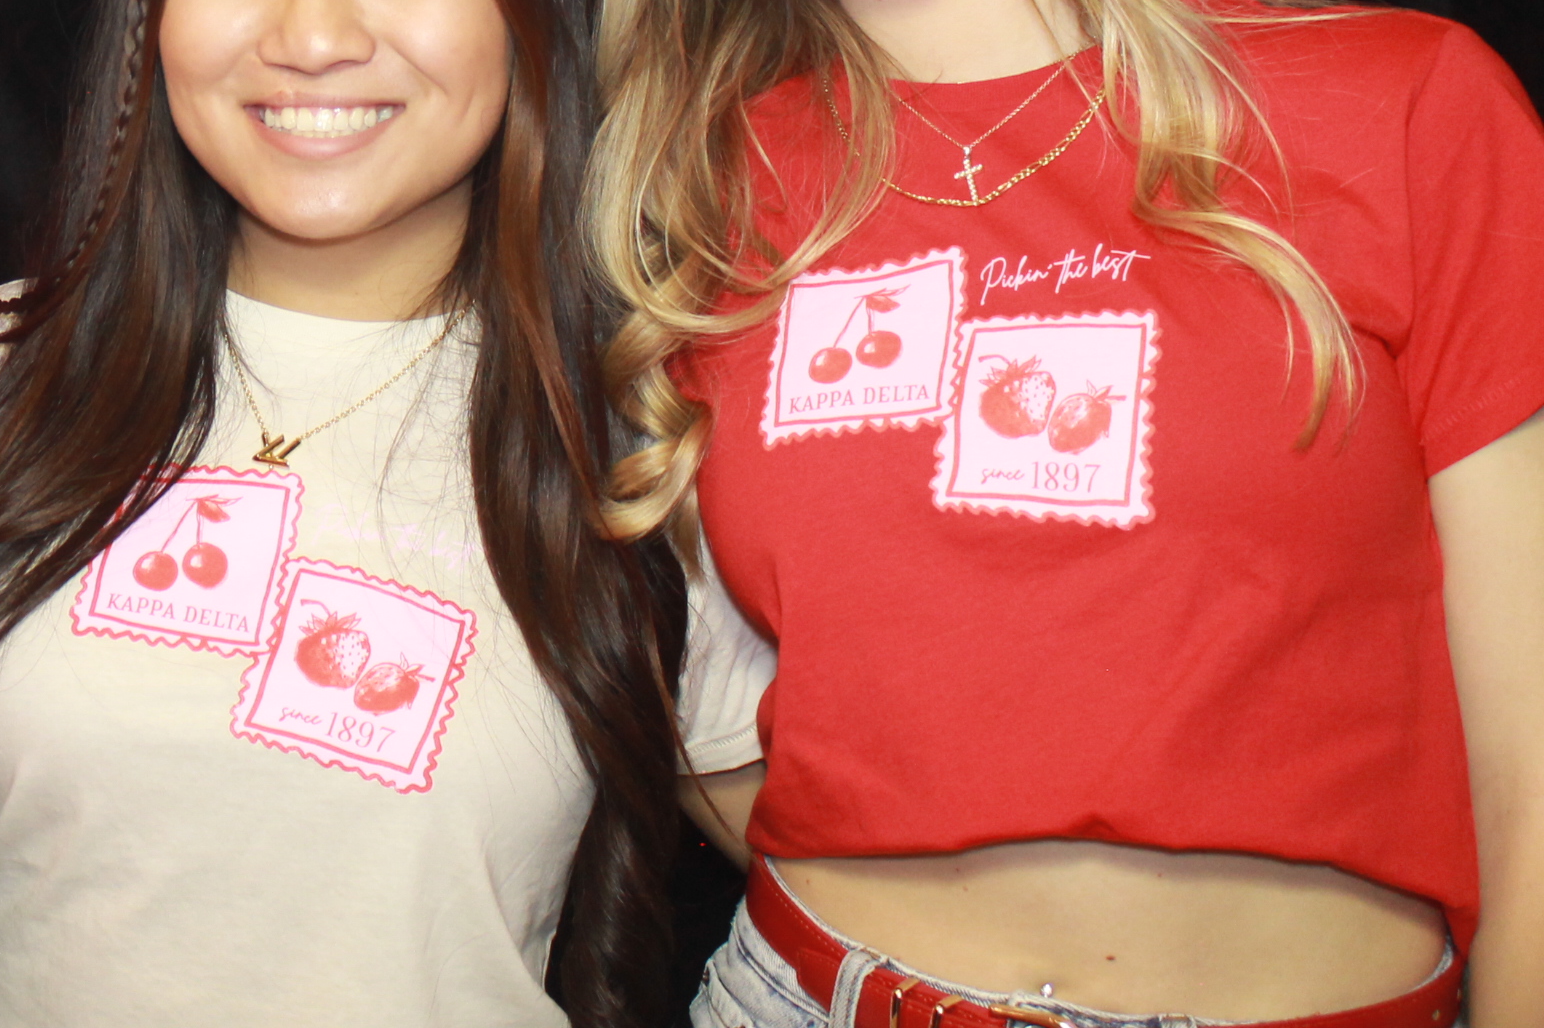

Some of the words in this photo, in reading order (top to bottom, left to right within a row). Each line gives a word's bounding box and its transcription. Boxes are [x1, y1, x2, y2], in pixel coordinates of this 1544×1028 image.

[1053, 248, 1088, 294] the
[1091, 243, 1151, 282] best
[789, 387, 855, 414] KAPPA
[862, 384, 930, 406] DELTA
[980, 466, 1025, 485] since
[1031, 461, 1101, 493] 1897
[107, 593, 176, 621] KAPPA
[183, 605, 250, 634] DELTA
[278, 706, 323, 727] since
[325, 711, 396, 754] 1897
